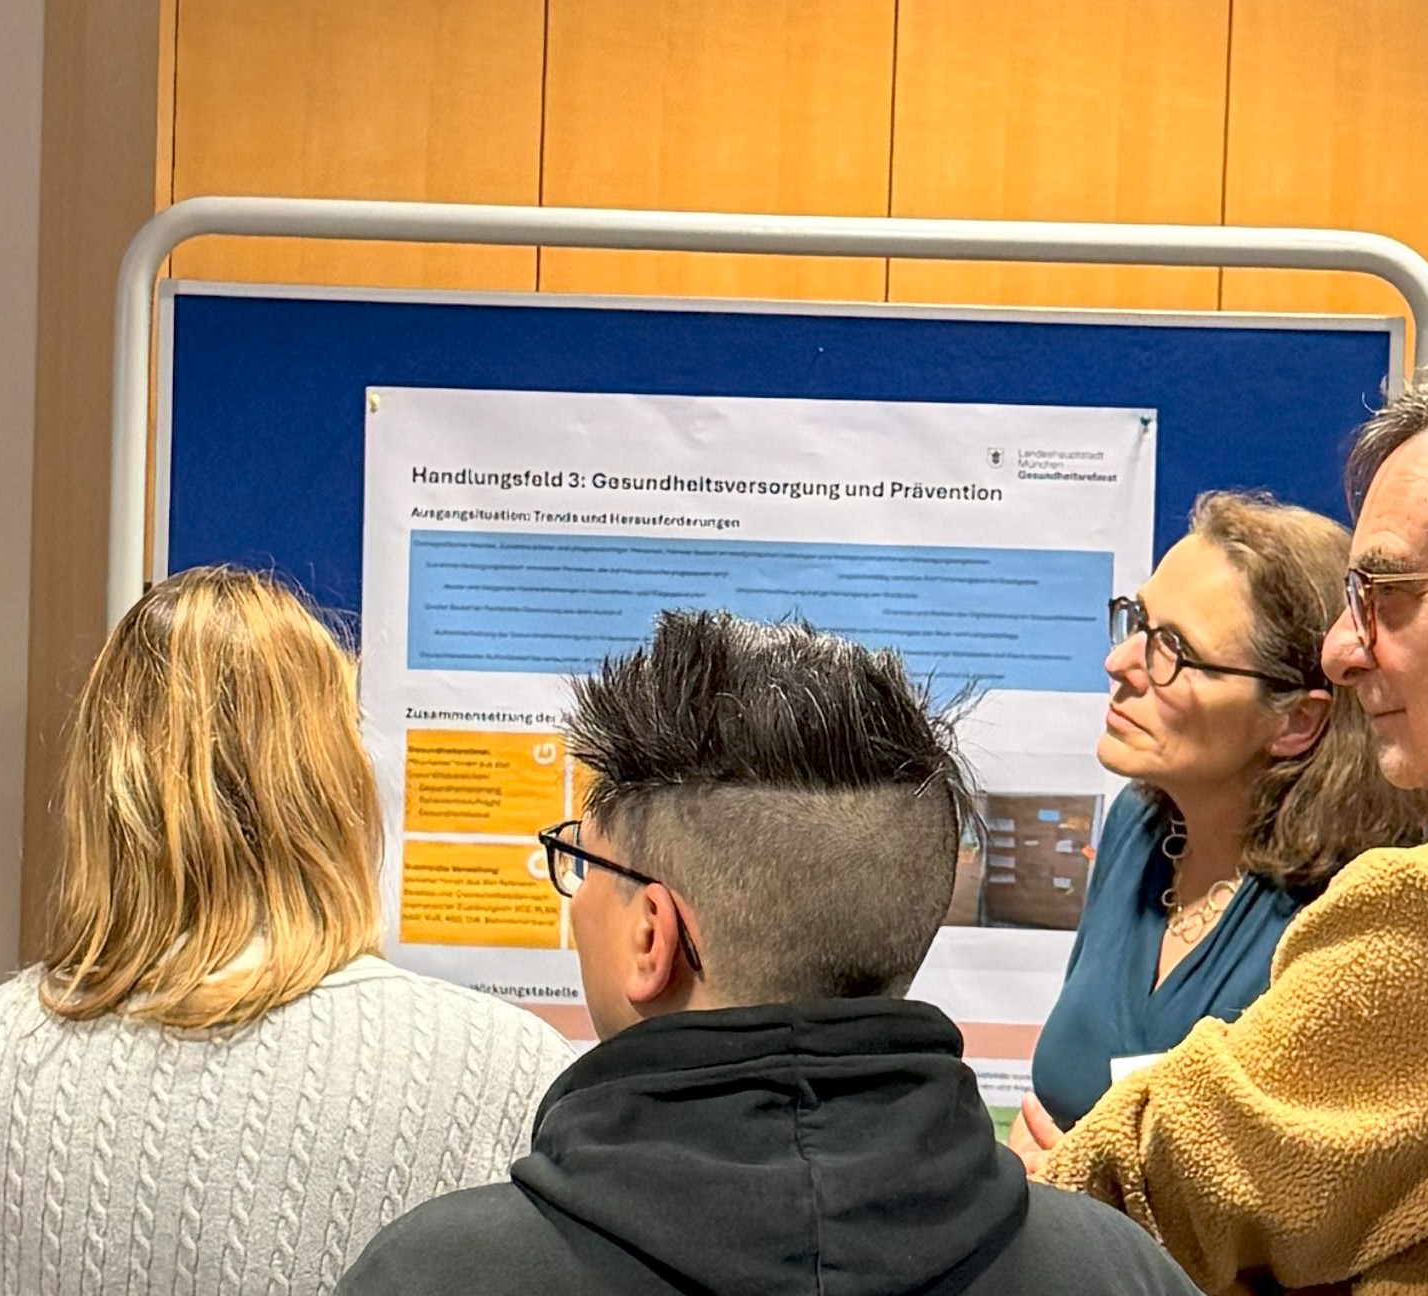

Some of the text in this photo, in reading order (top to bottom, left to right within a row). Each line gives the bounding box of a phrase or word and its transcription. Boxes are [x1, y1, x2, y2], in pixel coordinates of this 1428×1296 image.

[411, 467, 1003, 502] Handlungsfeld 3: Gesundheitsversorgung und Prävention
[534, 510, 578, 524] Trends
[581, 512, 607, 525] und
[610, 513, 741, 531] Herausforderungen
[405, 708, 533, 726] Zusammensetzung
